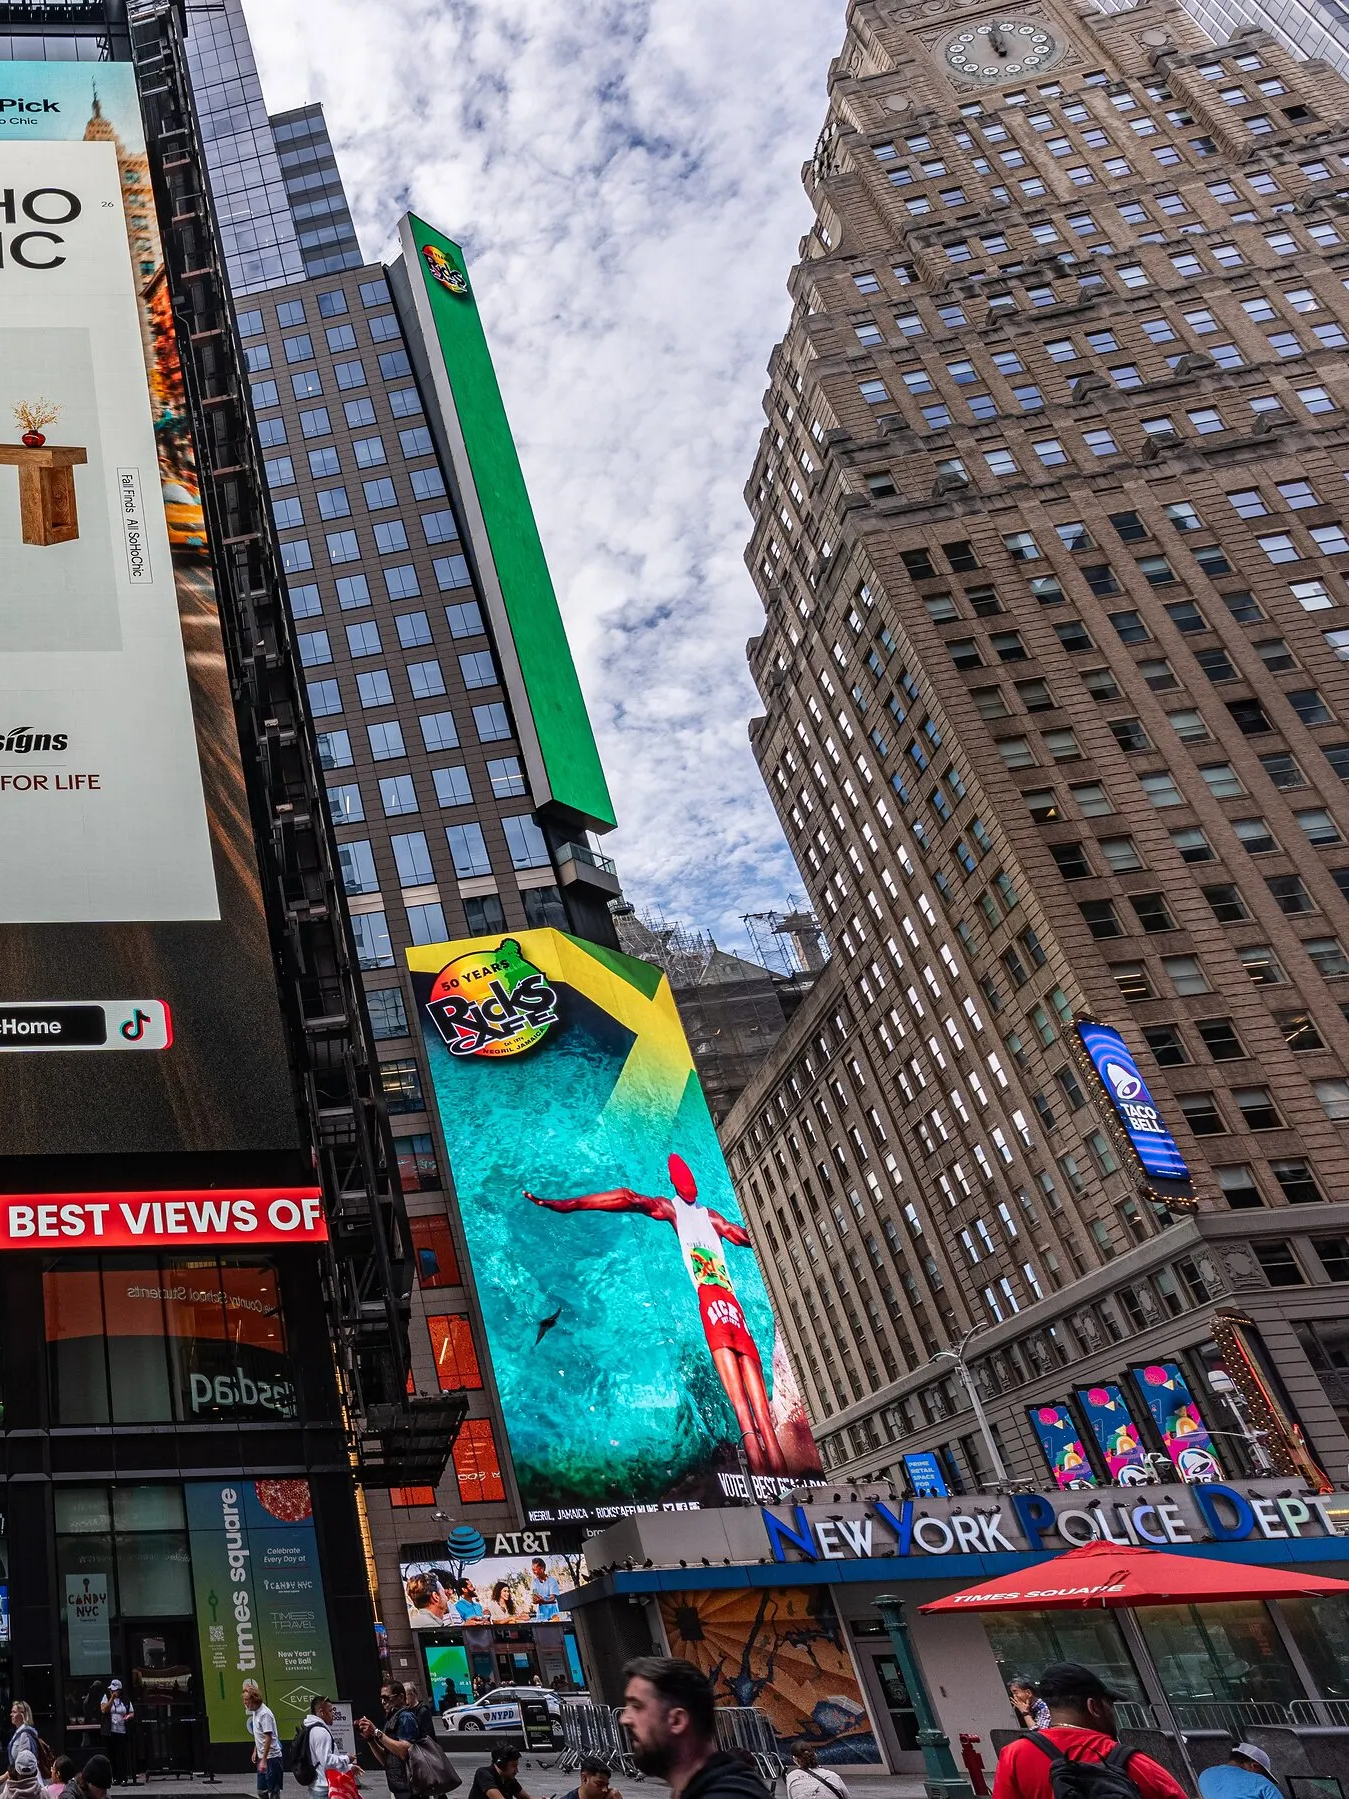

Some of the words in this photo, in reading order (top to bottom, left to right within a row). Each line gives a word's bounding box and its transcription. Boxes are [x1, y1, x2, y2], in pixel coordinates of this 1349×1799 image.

[9, 117, 38, 125] Chic
[121, 474, 134, 488] Fall
[123, 489, 137, 513] Finds
[126, 518, 139, 531] All
[0, 775, 49, 791] FOR
[54, 774, 101, 790] LIFE
[441, 979, 460, 992] 50
[461, 959, 511, 984] YEARS
[515, 1028, 546, 1051] JAMAICA
[1119, 1102, 1157, 1120] TACO
[1130, 1117, 1166, 1134] BELL
[8, 1203, 111, 1238] BEST
[120, 1200, 258, 1235] VIEWS
[268, 1199, 321, 1231] OF
[751, 1475, 778, 1499] BEST
[528, 1510, 555, 1522] NEGRIL,
[557, 1508, 589, 1520] JAMAICA
[762, 1505, 872, 1562] NEW
[871, 1500, 1017, 1558] YORK
[1011, 1494, 1192, 1550] POLICE
[1192, 1483, 1338, 1541] DEPT
[221, 1488, 250, 1582] square
[493, 1530, 552, 1555] AT&T
[267, 1547, 301, 1555] Celebrate
[263, 1556, 282, 1564] Every
[283, 1555, 297, 1563] Day
[297, 1580, 313, 1589] NYC
[68, 1592, 107, 1605] CANDY
[953, 1592, 1021, 1604] TIMES
[76, 1605, 99, 1618] NYC
[270, 1611, 315, 1620] TIMES
[233, 1590, 256, 1672] times
[270, 1620, 316, 1629] TRAVEL
[294, 1650, 317, 1658] Year's
[491, 1710, 515, 1721] NYPD
